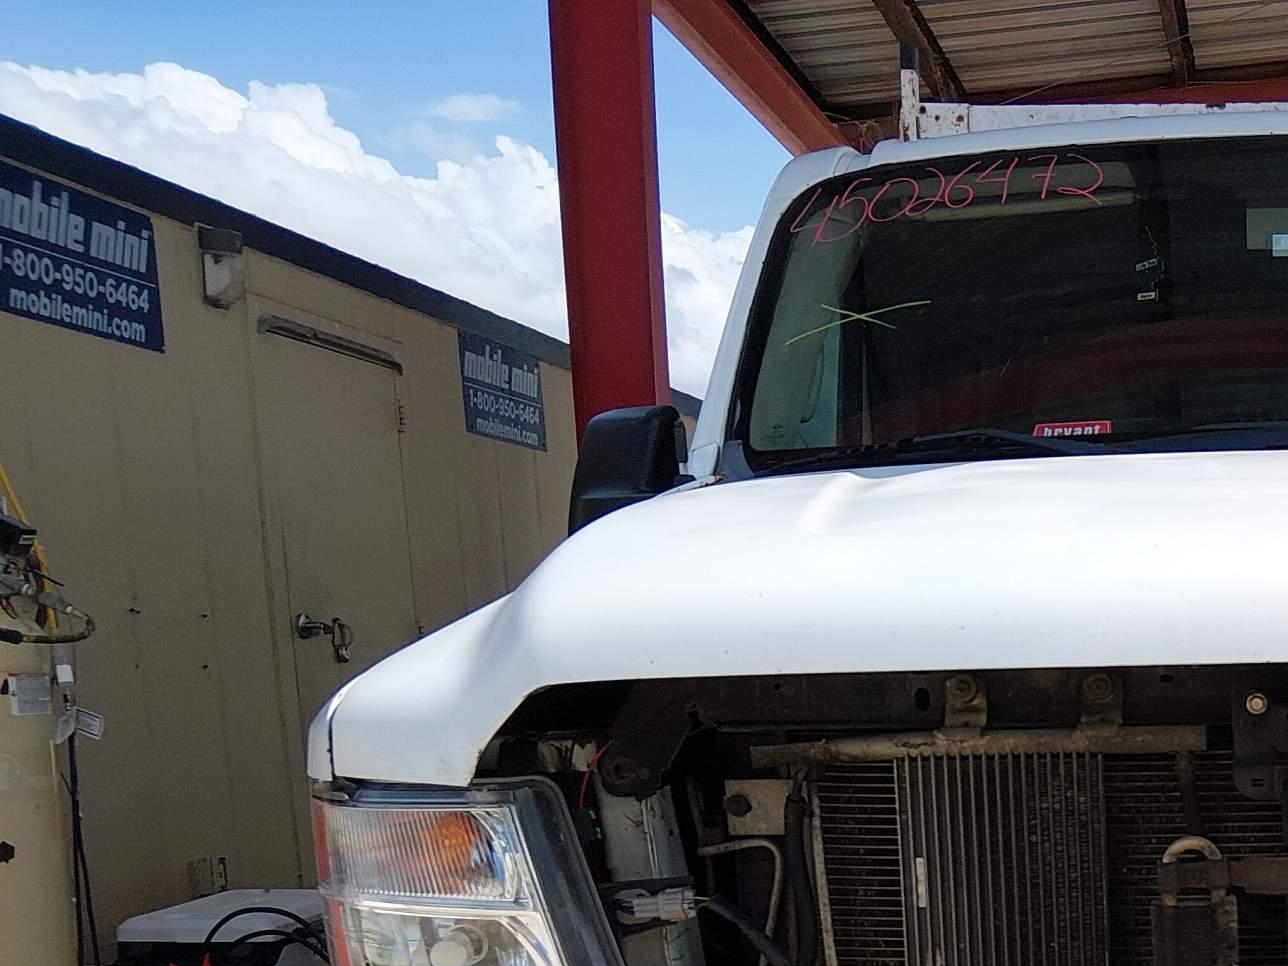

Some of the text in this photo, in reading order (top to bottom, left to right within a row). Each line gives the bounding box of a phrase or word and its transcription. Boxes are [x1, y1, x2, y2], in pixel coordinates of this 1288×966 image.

[790, 154, 1103, 246] 45026472
[90, 220, 152, 273] mini
[9, 287, 147, 343] mobilemini.com
[464, 345, 538, 398] mobile mini
[476, 417, 539, 446] mobilemini.com
